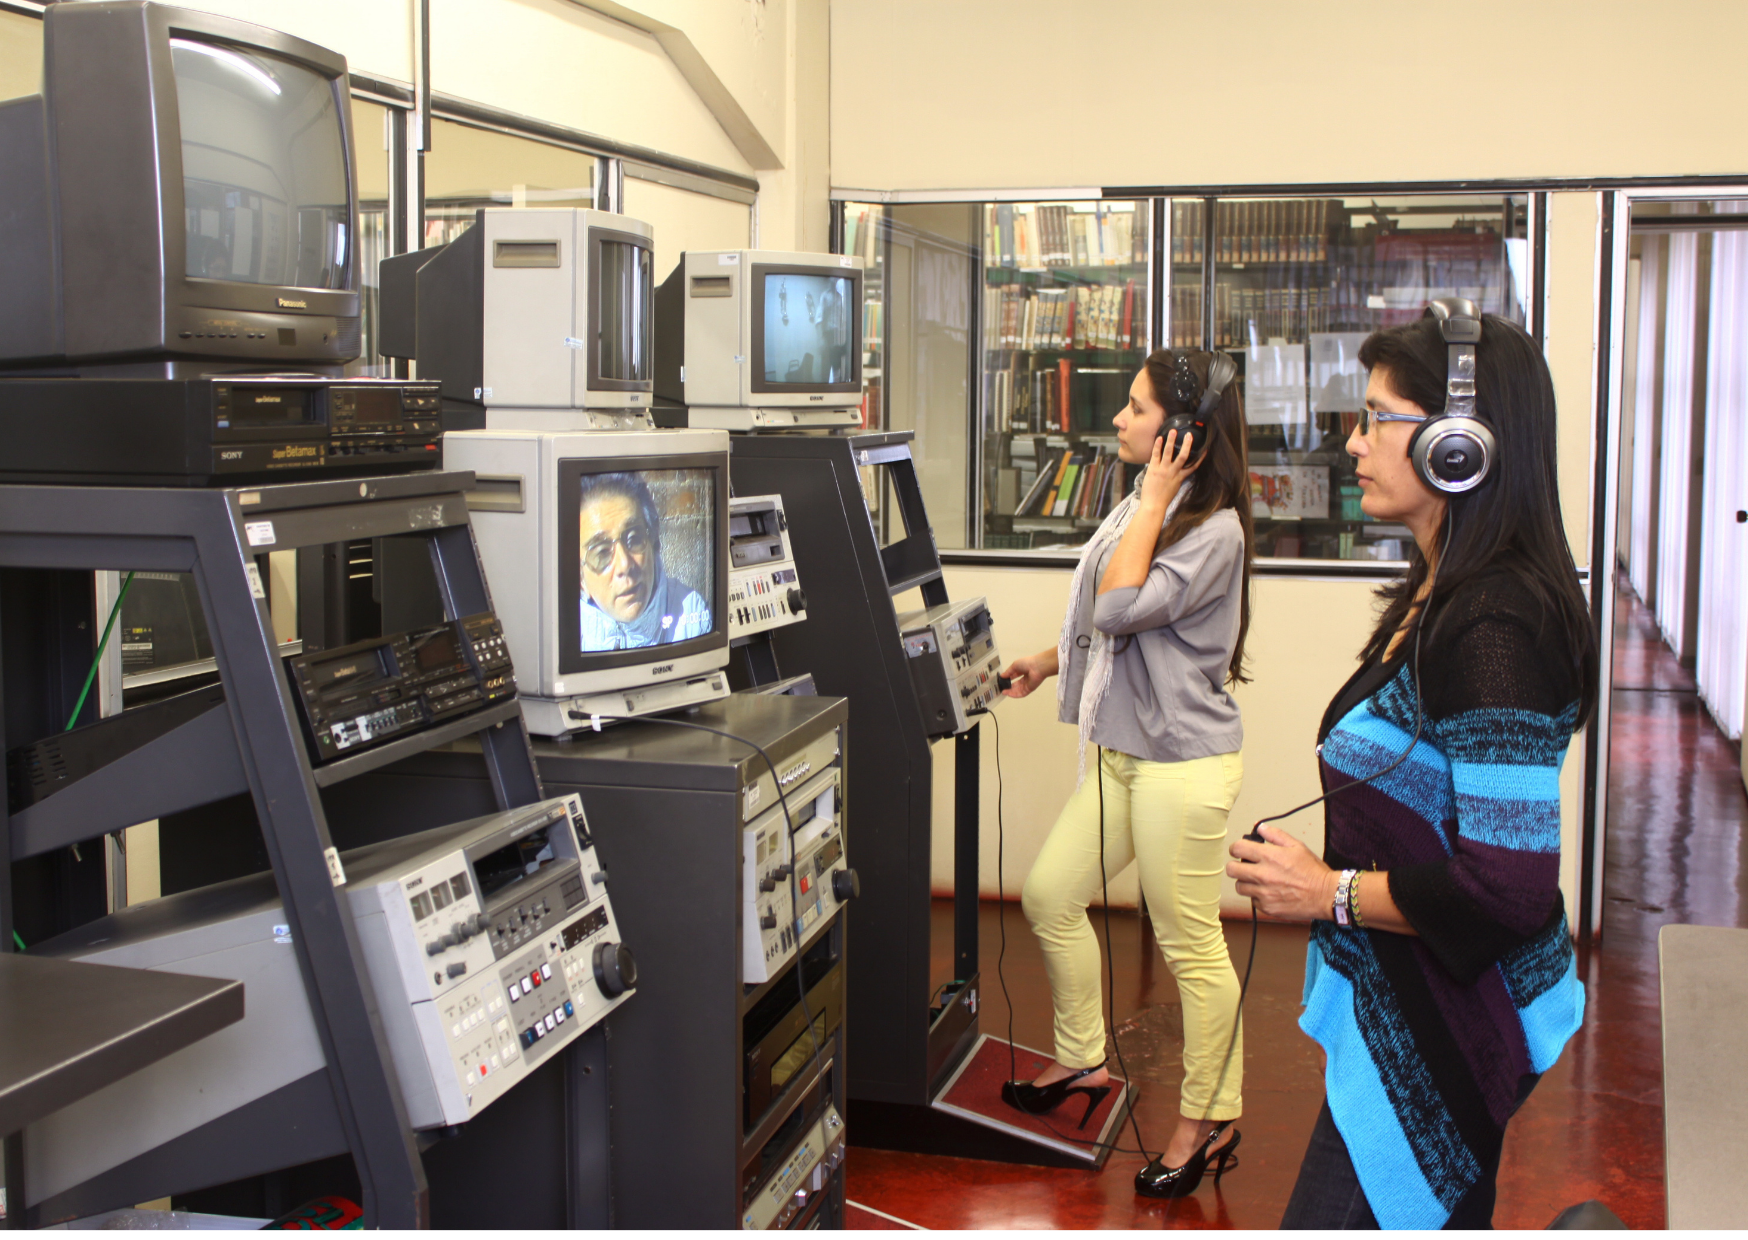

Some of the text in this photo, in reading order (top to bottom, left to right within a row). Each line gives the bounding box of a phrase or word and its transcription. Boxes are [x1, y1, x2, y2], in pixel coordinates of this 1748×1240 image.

[278, 298, 307, 309] Panasonic
[220, 451, 243, 460] SONY
[661, 615, 673, 630] SP
[652, 663, 674, 676] SONY
